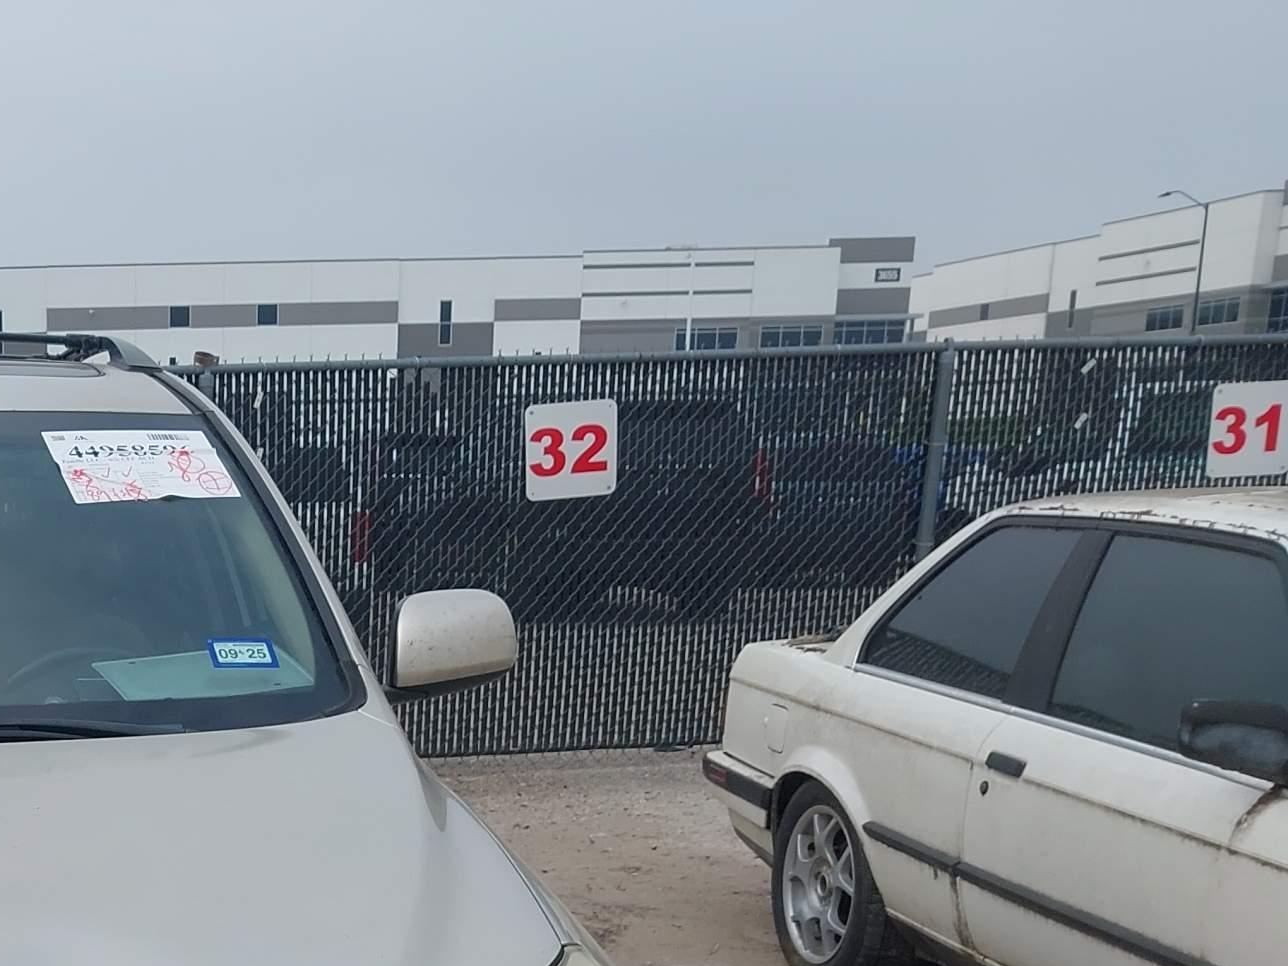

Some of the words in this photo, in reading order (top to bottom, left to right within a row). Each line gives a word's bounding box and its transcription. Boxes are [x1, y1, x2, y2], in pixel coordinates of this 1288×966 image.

[530, 424, 608, 478] 32
[1212, 404, 1282, 455] 31
[218, 648, 239, 659] 09
[246, 648, 267, 659] 25
